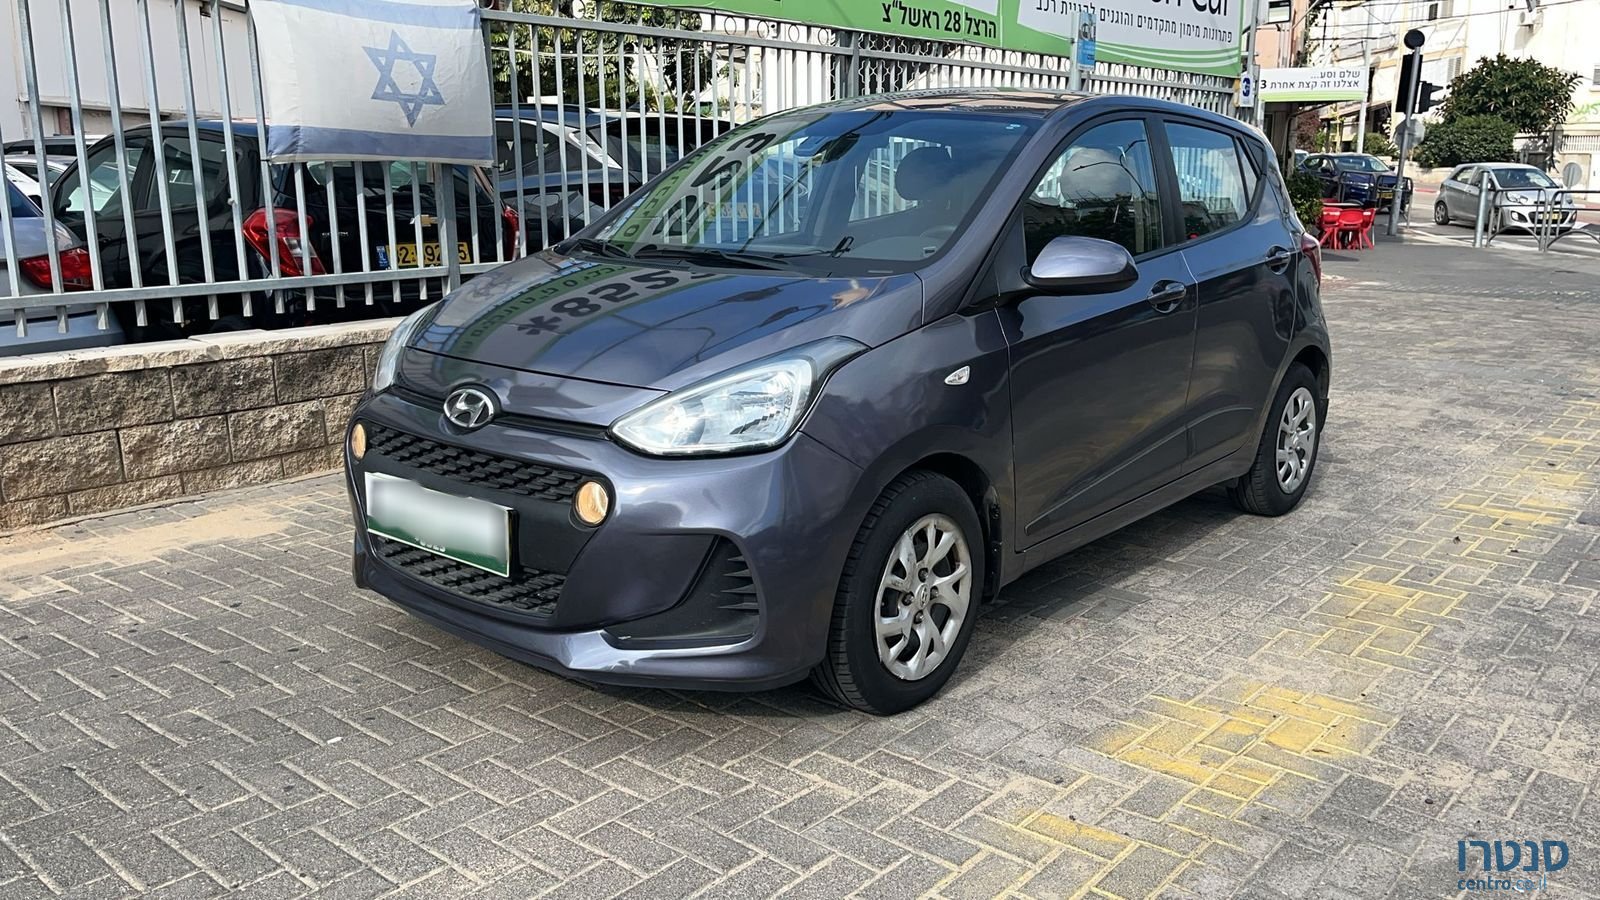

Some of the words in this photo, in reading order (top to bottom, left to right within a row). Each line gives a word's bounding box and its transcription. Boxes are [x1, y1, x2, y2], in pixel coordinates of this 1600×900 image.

[944, 10, 961, 33] 28
[965, 12, 997, 39] הרצל
[1100, 8, 1134, 27] והוגנים
[1137, 15, 1177, 35] מתקדמים
[1180, 22, 1200, 39] מימון
[1203, 26, 1233, 43] פתרונות
[1339, 70, 1361, 79] שלם
[1270, 80, 1295, 89] אחרת
[1298, 80, 1318, 90] קצת
[1320, 80, 1331, 88] זה
[1333, 79, 1360, 88] אצלנו
